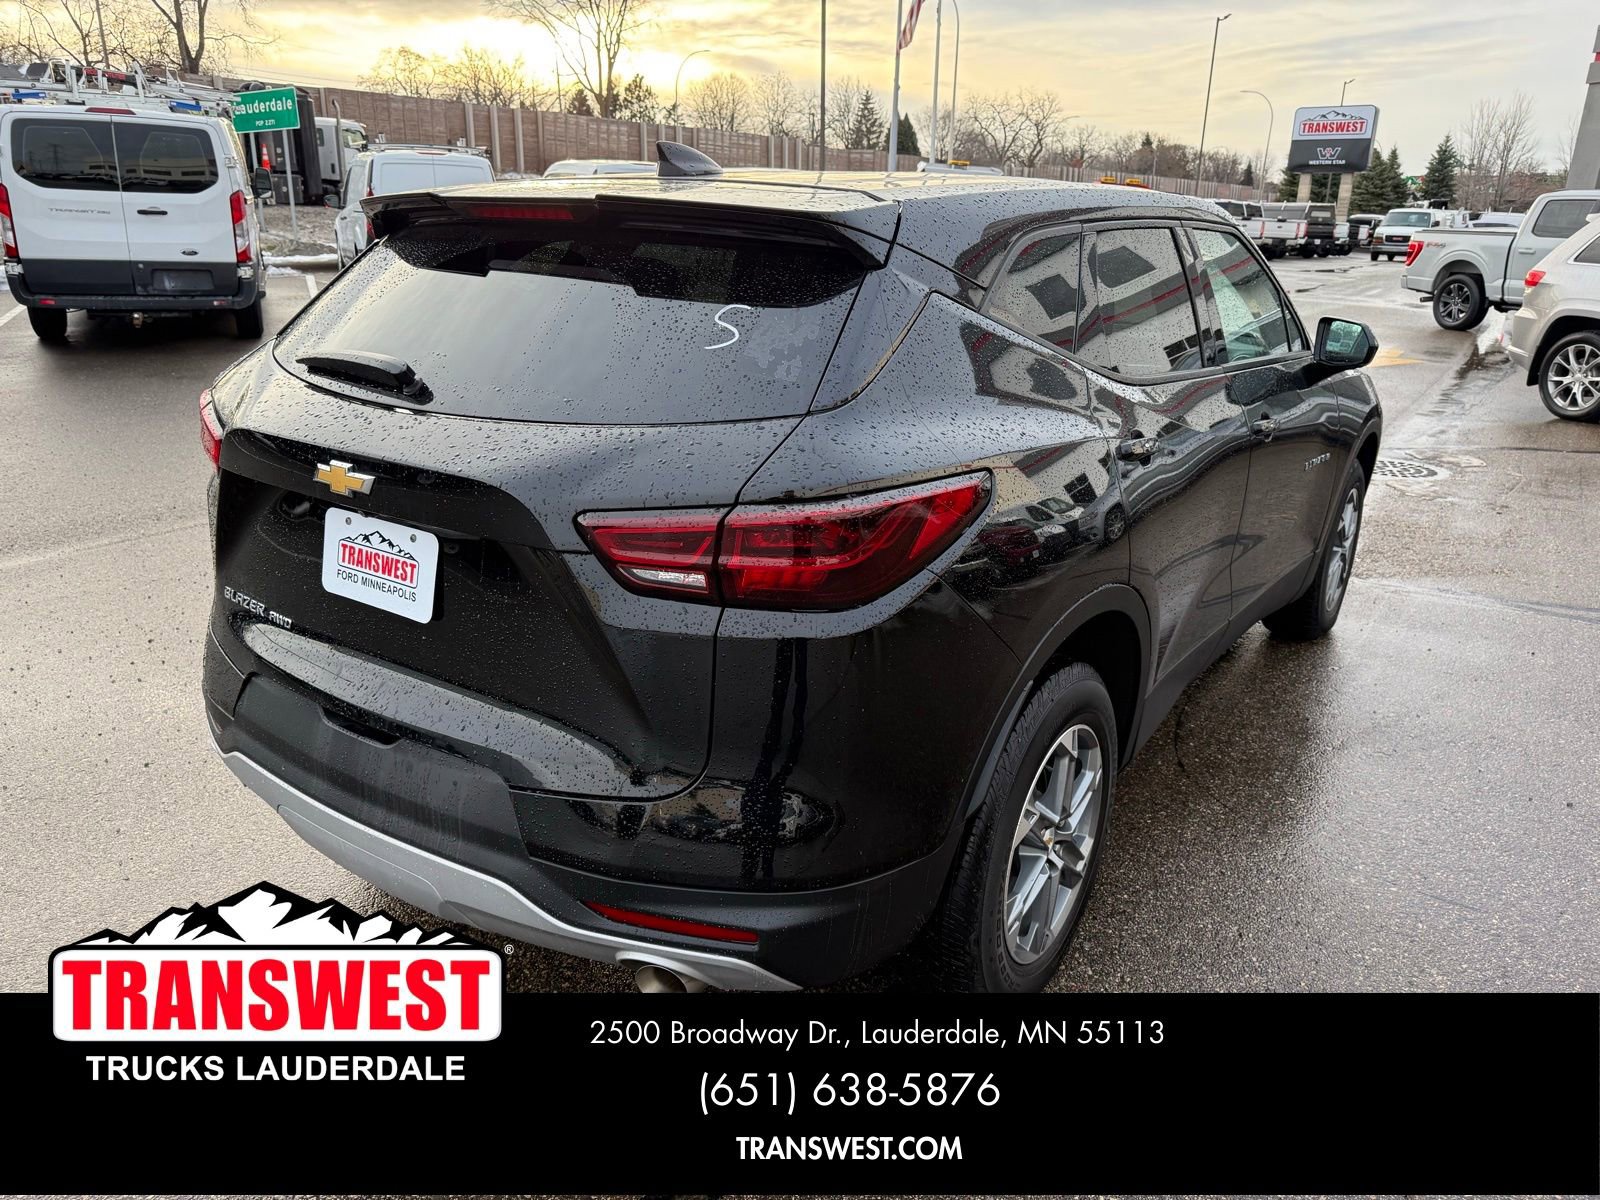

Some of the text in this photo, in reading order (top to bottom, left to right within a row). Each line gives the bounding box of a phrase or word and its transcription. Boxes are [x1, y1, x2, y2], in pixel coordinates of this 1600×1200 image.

[1302, 121, 1366, 133] TRANSWEST
[704, 304, 752, 350] S
[340, 543, 417, 584] TRANSWEST
[337, 569, 417, 602] FORD MINNEAPOLIS
[224, 585, 292, 629] BLAZER AWD
